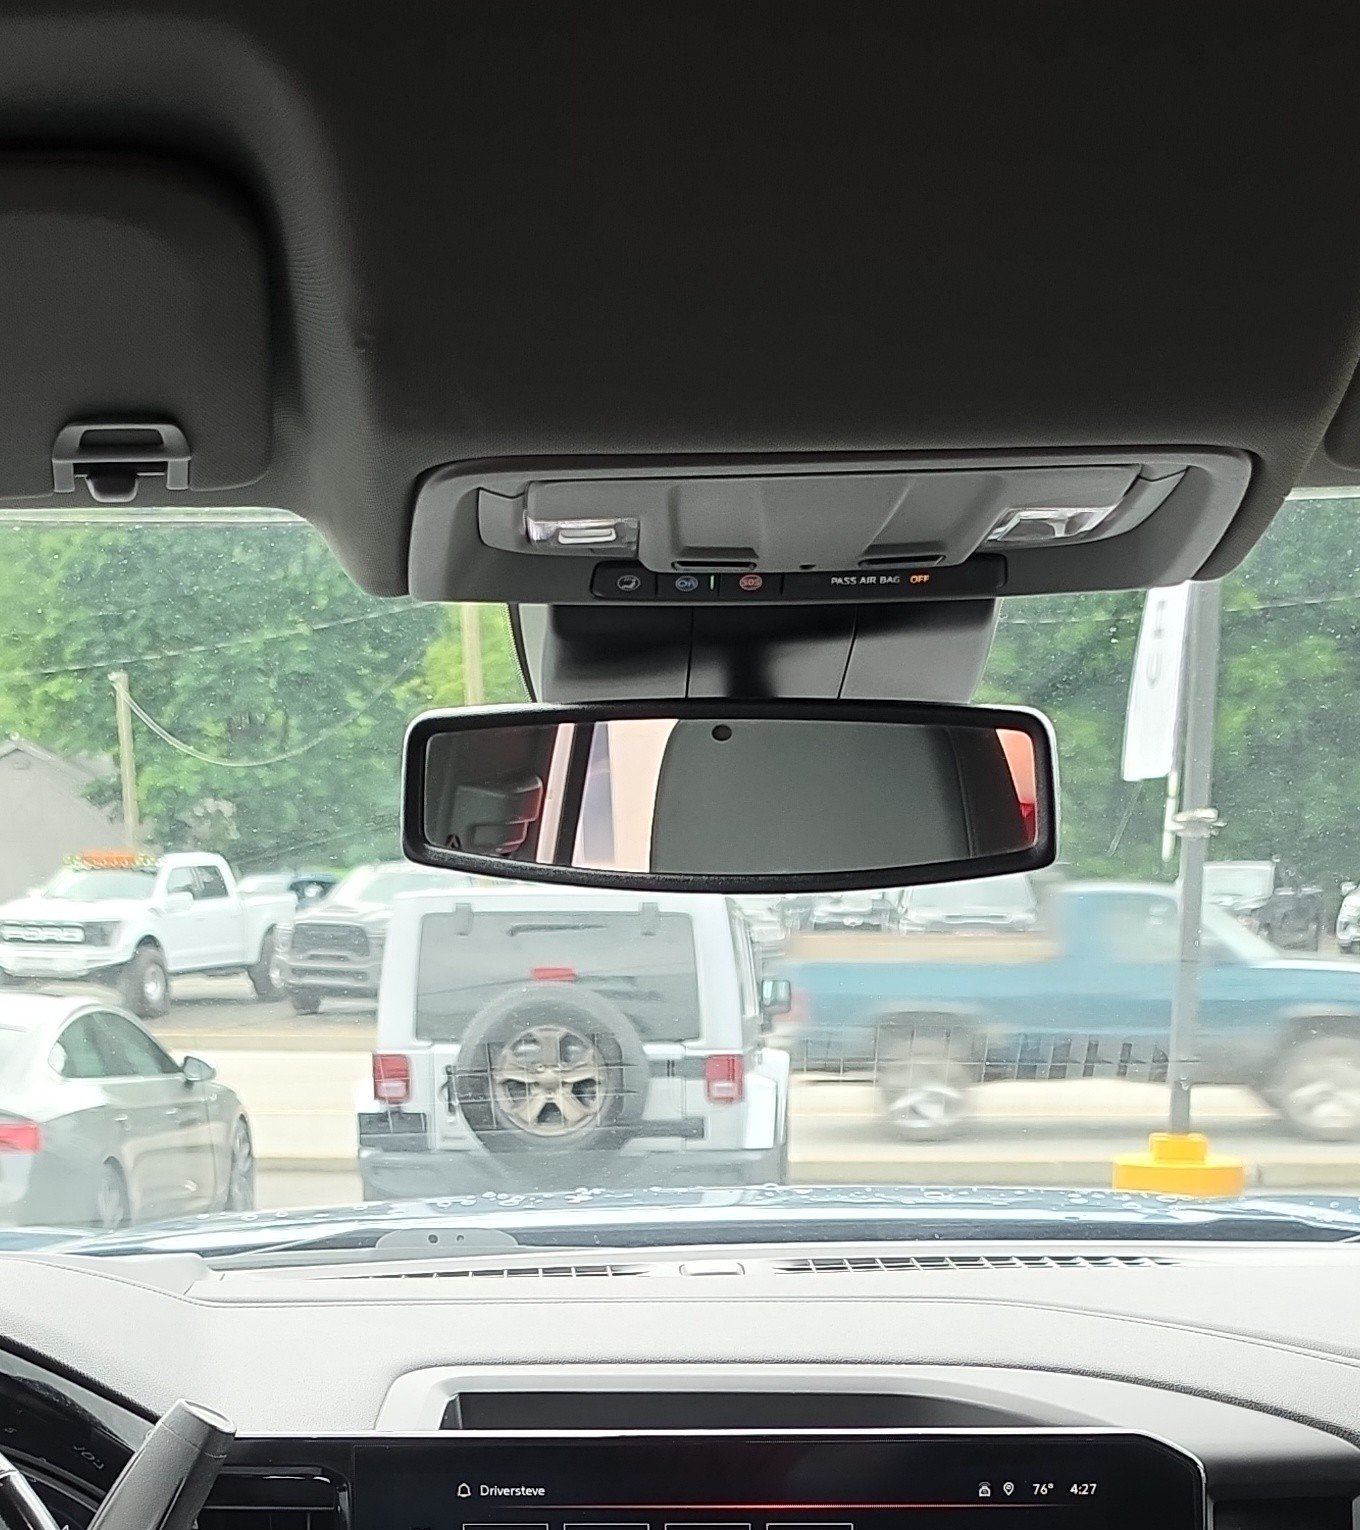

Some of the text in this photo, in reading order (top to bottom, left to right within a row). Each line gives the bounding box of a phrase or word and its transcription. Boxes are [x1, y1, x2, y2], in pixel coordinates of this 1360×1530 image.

[831, 574, 930, 585] PASS AIR BAG OFF
[0, 922, 84, 943] FORD
[480, 1484, 545, 1497] Driversteve
[1032, 1483, 1097, 1496] 76° 4:27
